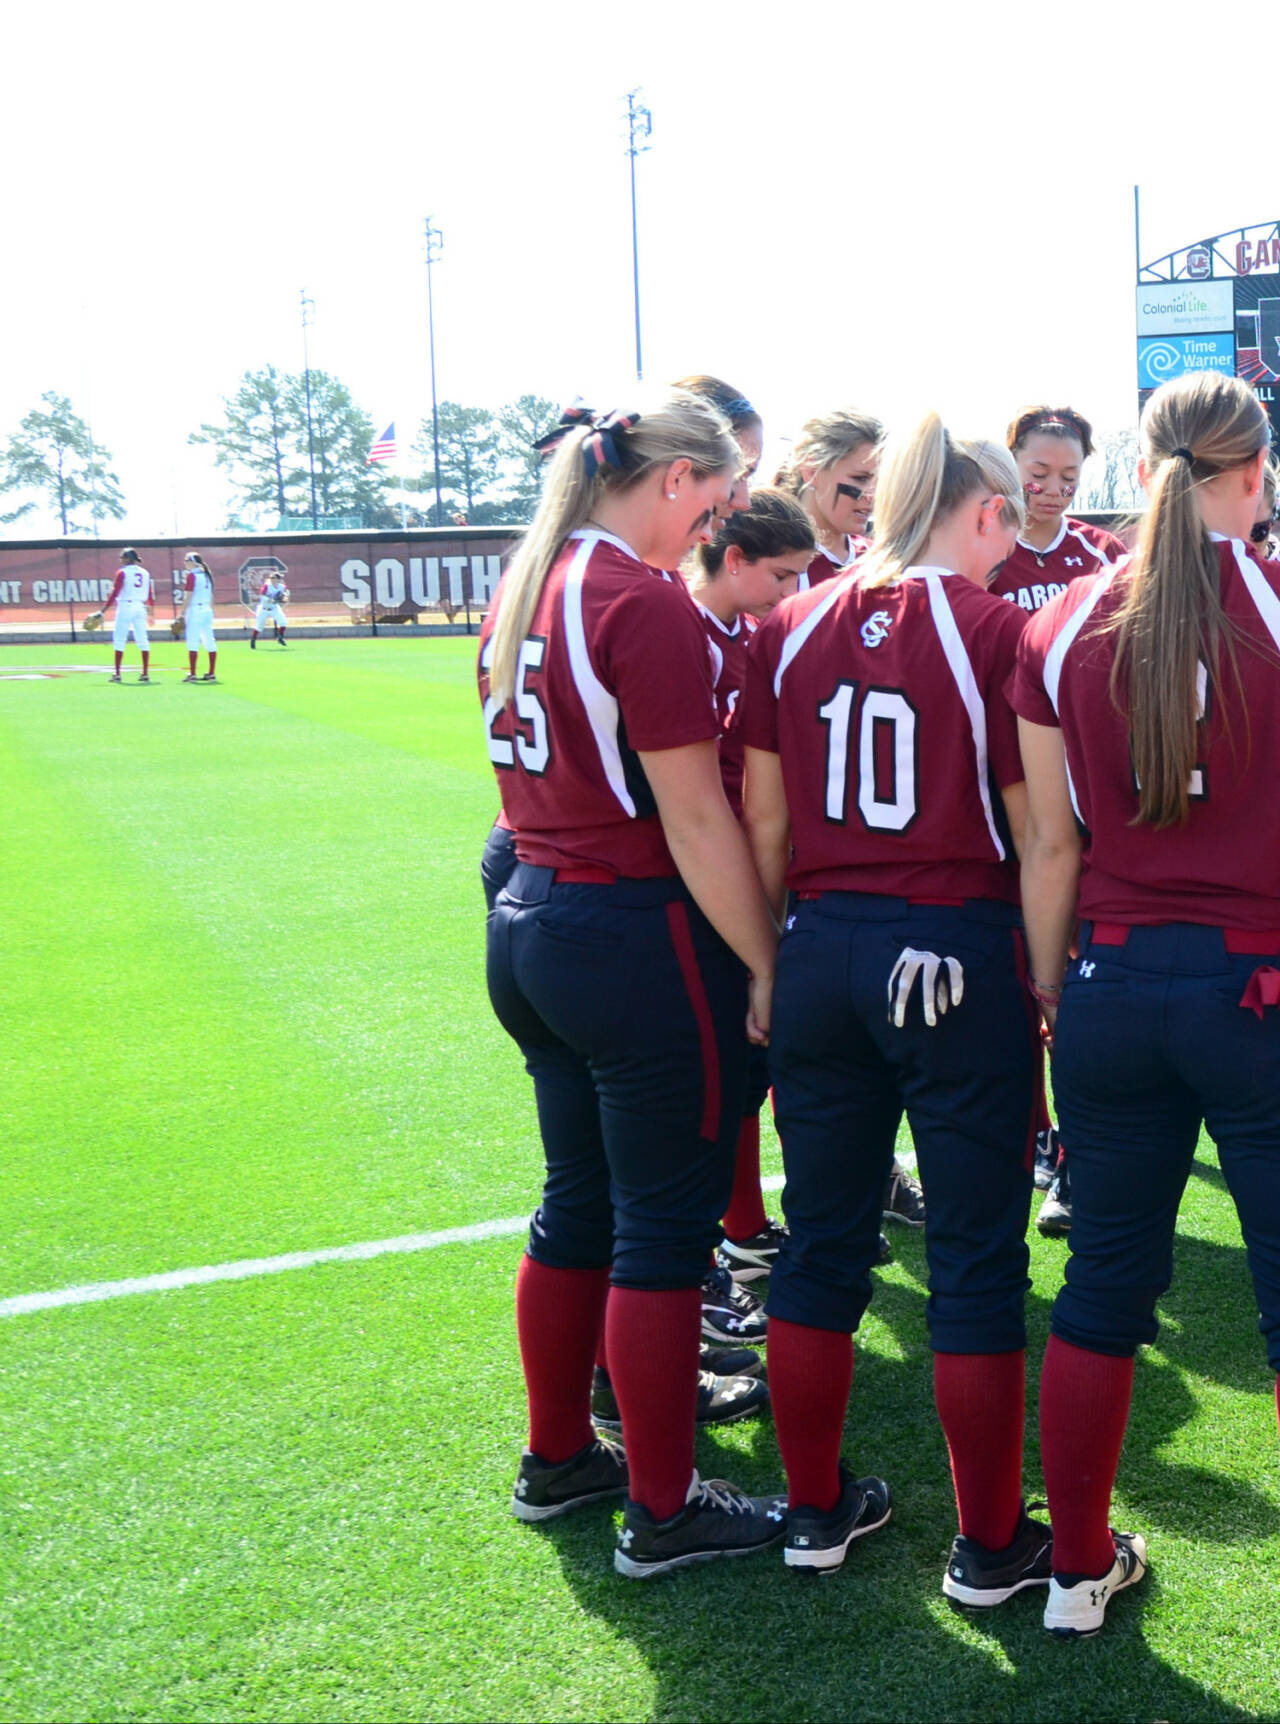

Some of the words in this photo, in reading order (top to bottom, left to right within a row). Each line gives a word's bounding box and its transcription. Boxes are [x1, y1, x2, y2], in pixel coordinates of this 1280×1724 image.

[1143, 301, 1186, 314] Colonial
[1188, 301, 1208, 312] Life
[1184, 340, 1217, 353] Time
[1184, 355, 1233, 368] Warner
[1253, 388, 1275, 401] ALL
[134, 573, 144, 588] 3
[340, 555, 501, 610] SOUTH
[481, 635, 551, 775] 25
[817, 681, 919, 835] 10
